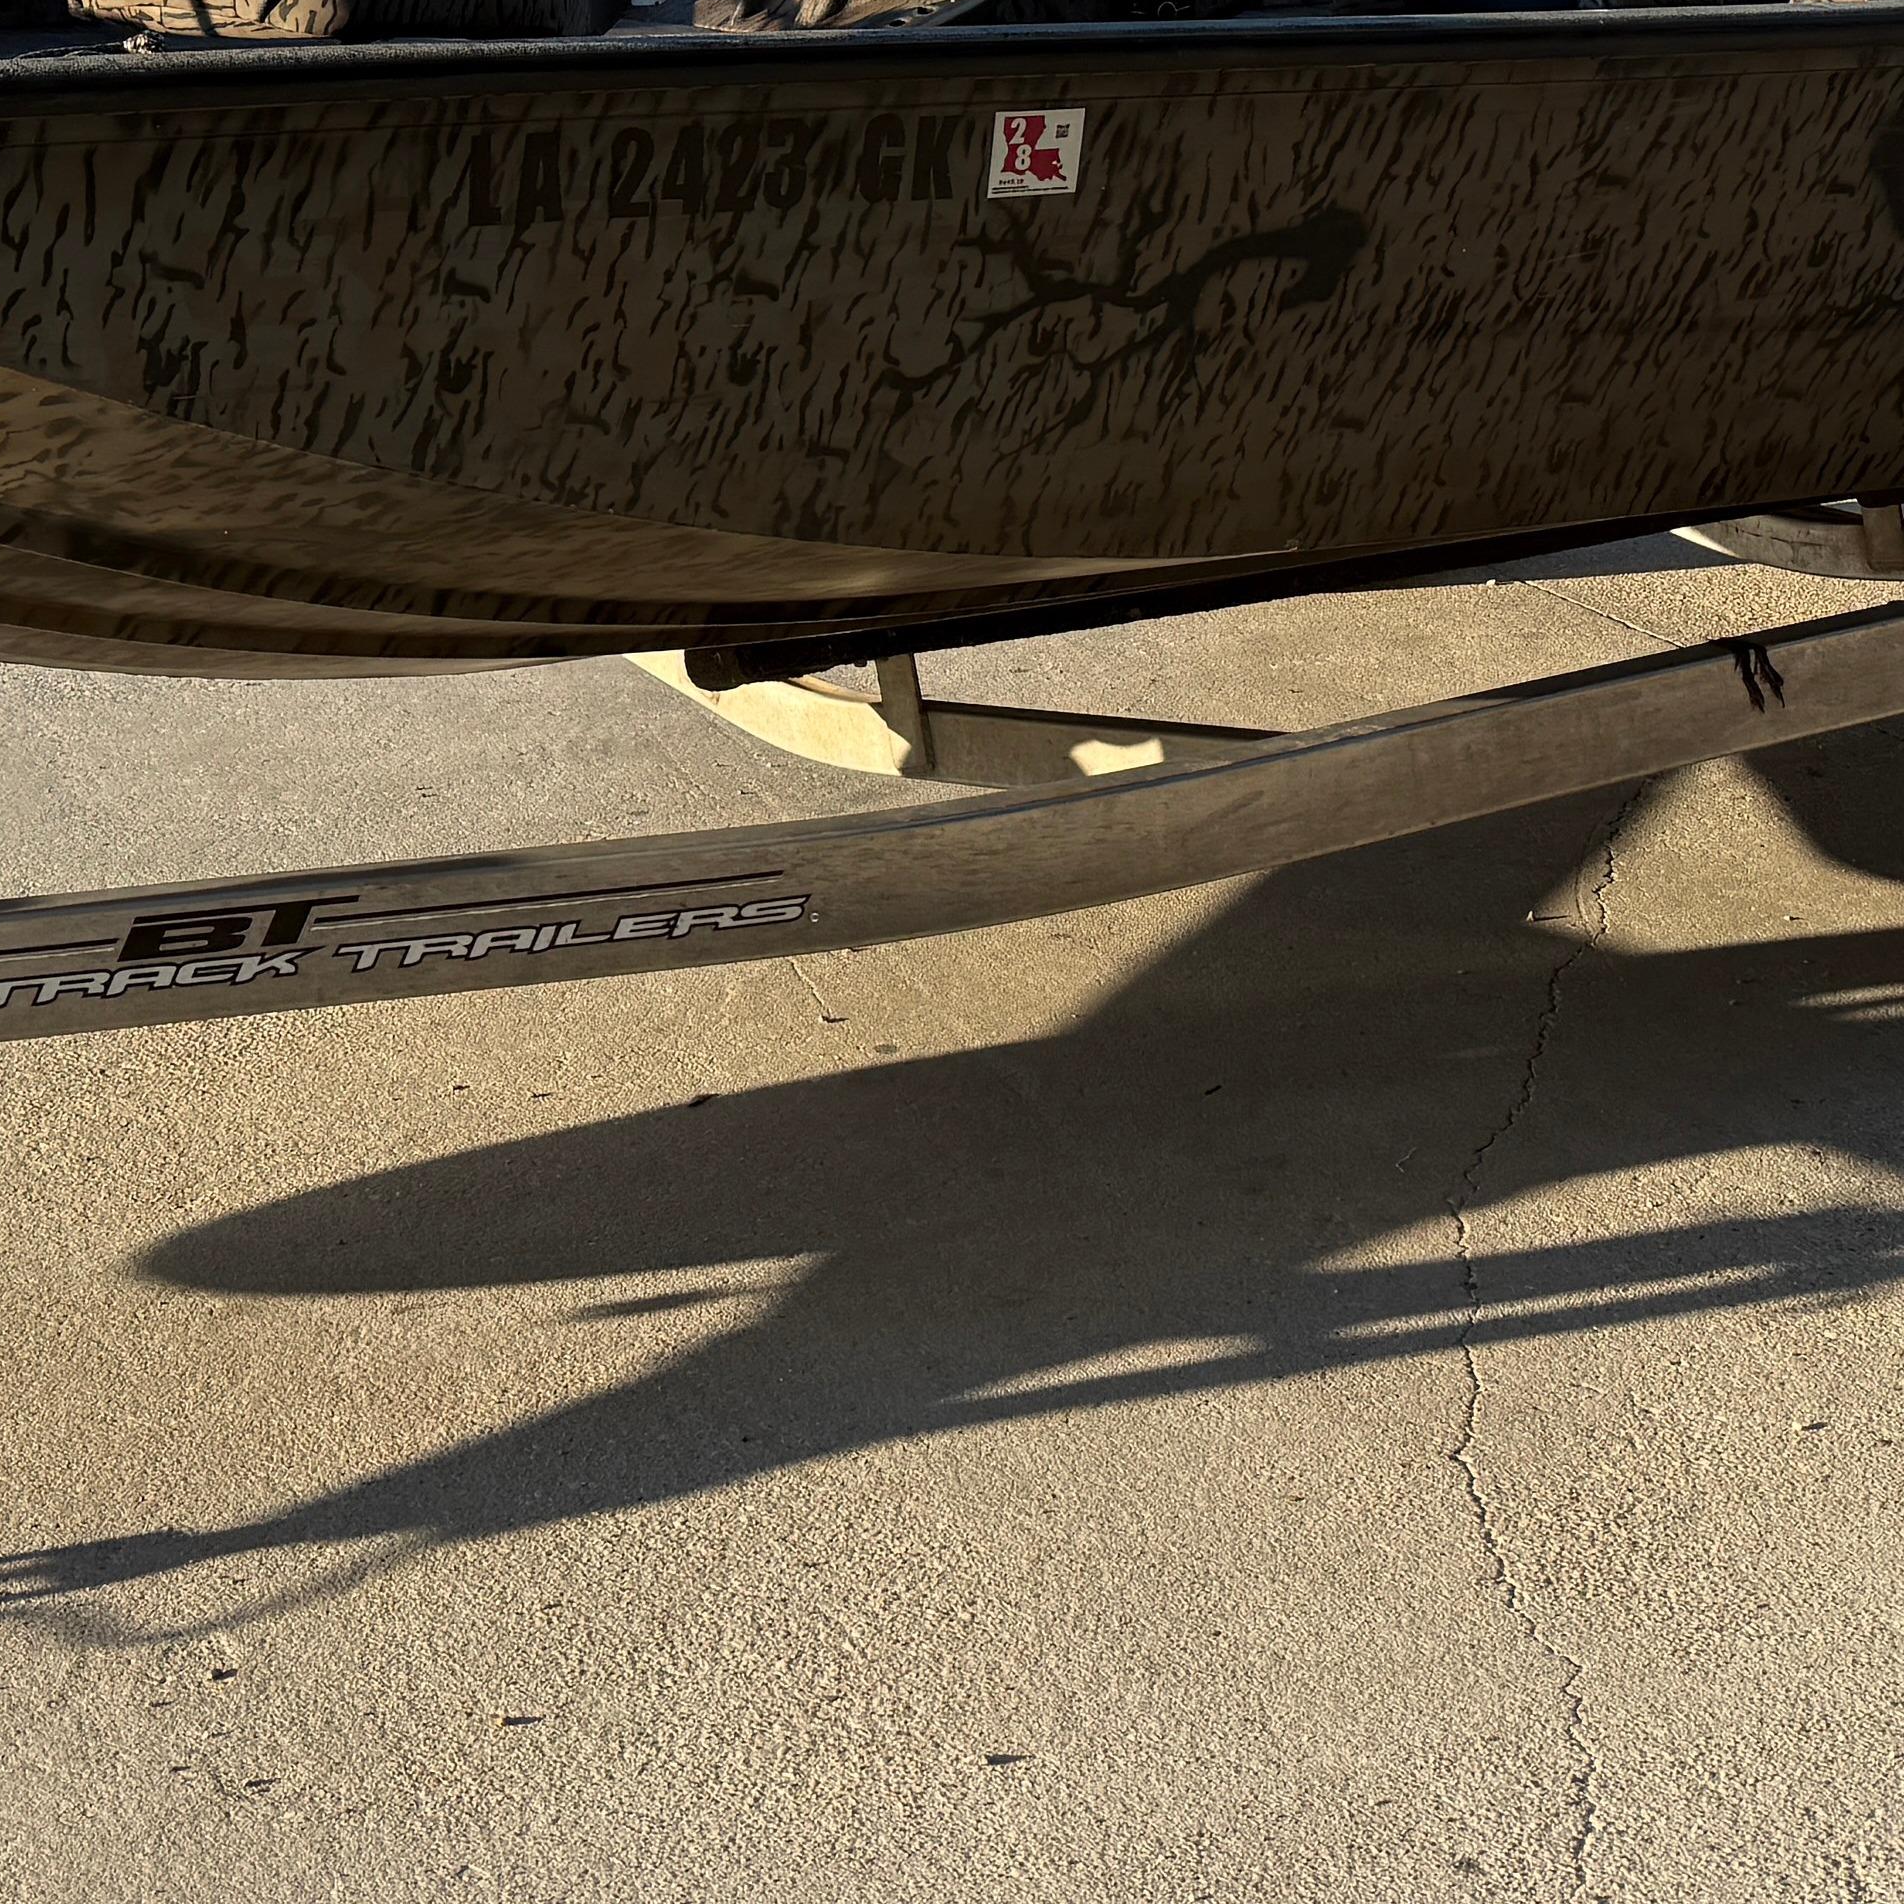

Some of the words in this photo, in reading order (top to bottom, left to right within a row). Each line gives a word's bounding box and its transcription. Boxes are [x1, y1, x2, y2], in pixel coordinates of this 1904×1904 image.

[467, 128, 564, 228] LA
[858, 113, 960, 202] GK
[332, 894, 812, 974] TRAILERS
